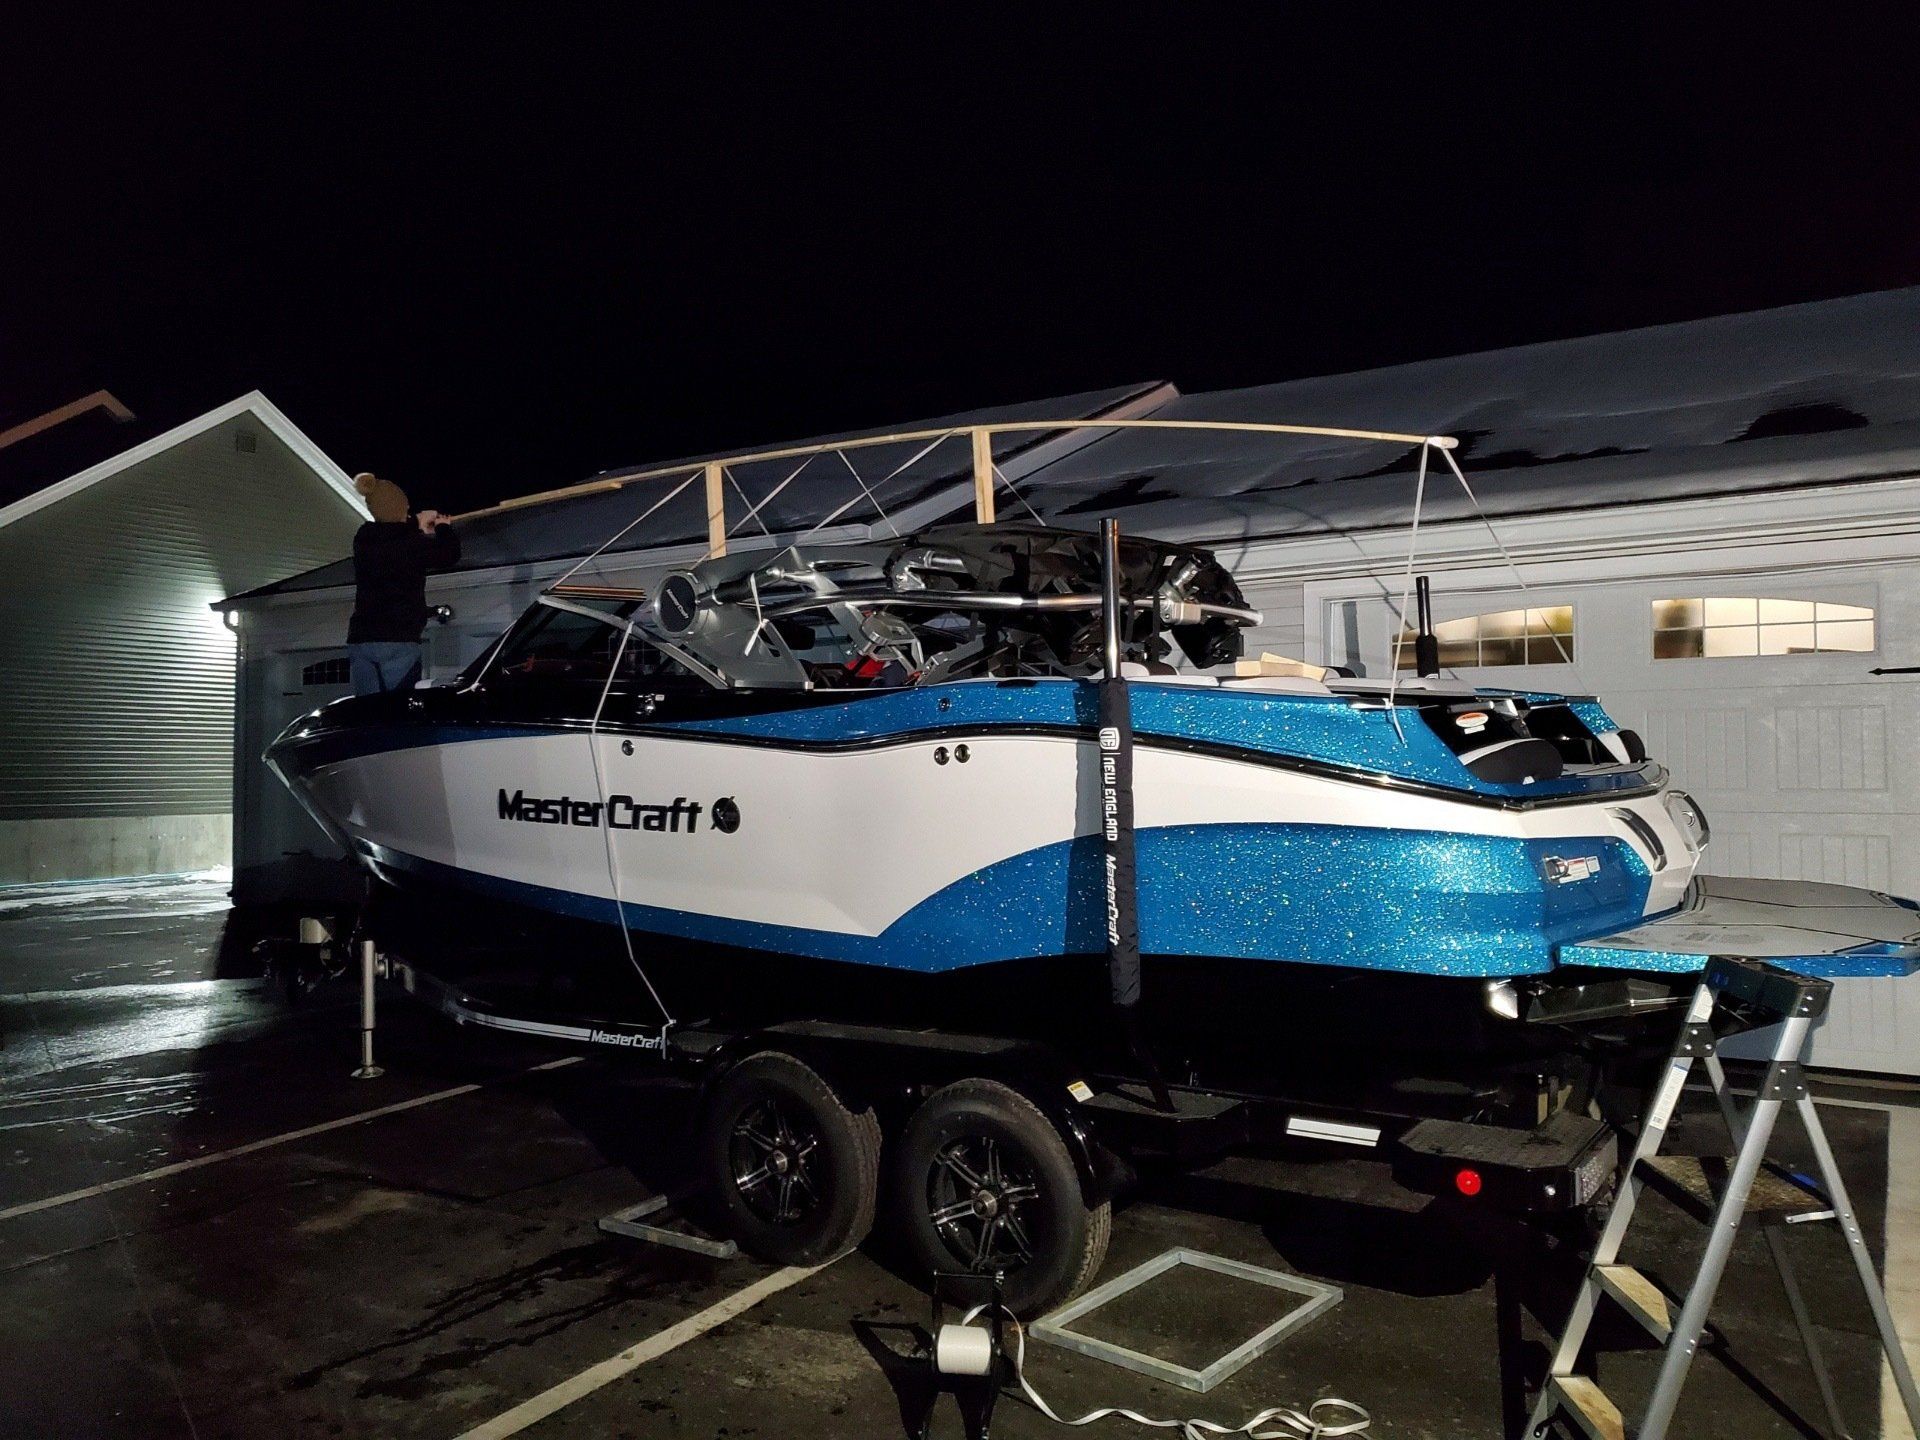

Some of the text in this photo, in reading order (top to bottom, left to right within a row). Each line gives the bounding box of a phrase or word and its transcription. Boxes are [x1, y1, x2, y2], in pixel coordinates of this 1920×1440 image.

[498, 788, 703, 833] MasterCraft
[1103, 757, 1118, 841] NEW ENGLAND
[1106, 854, 1120, 945] MasterCraft
